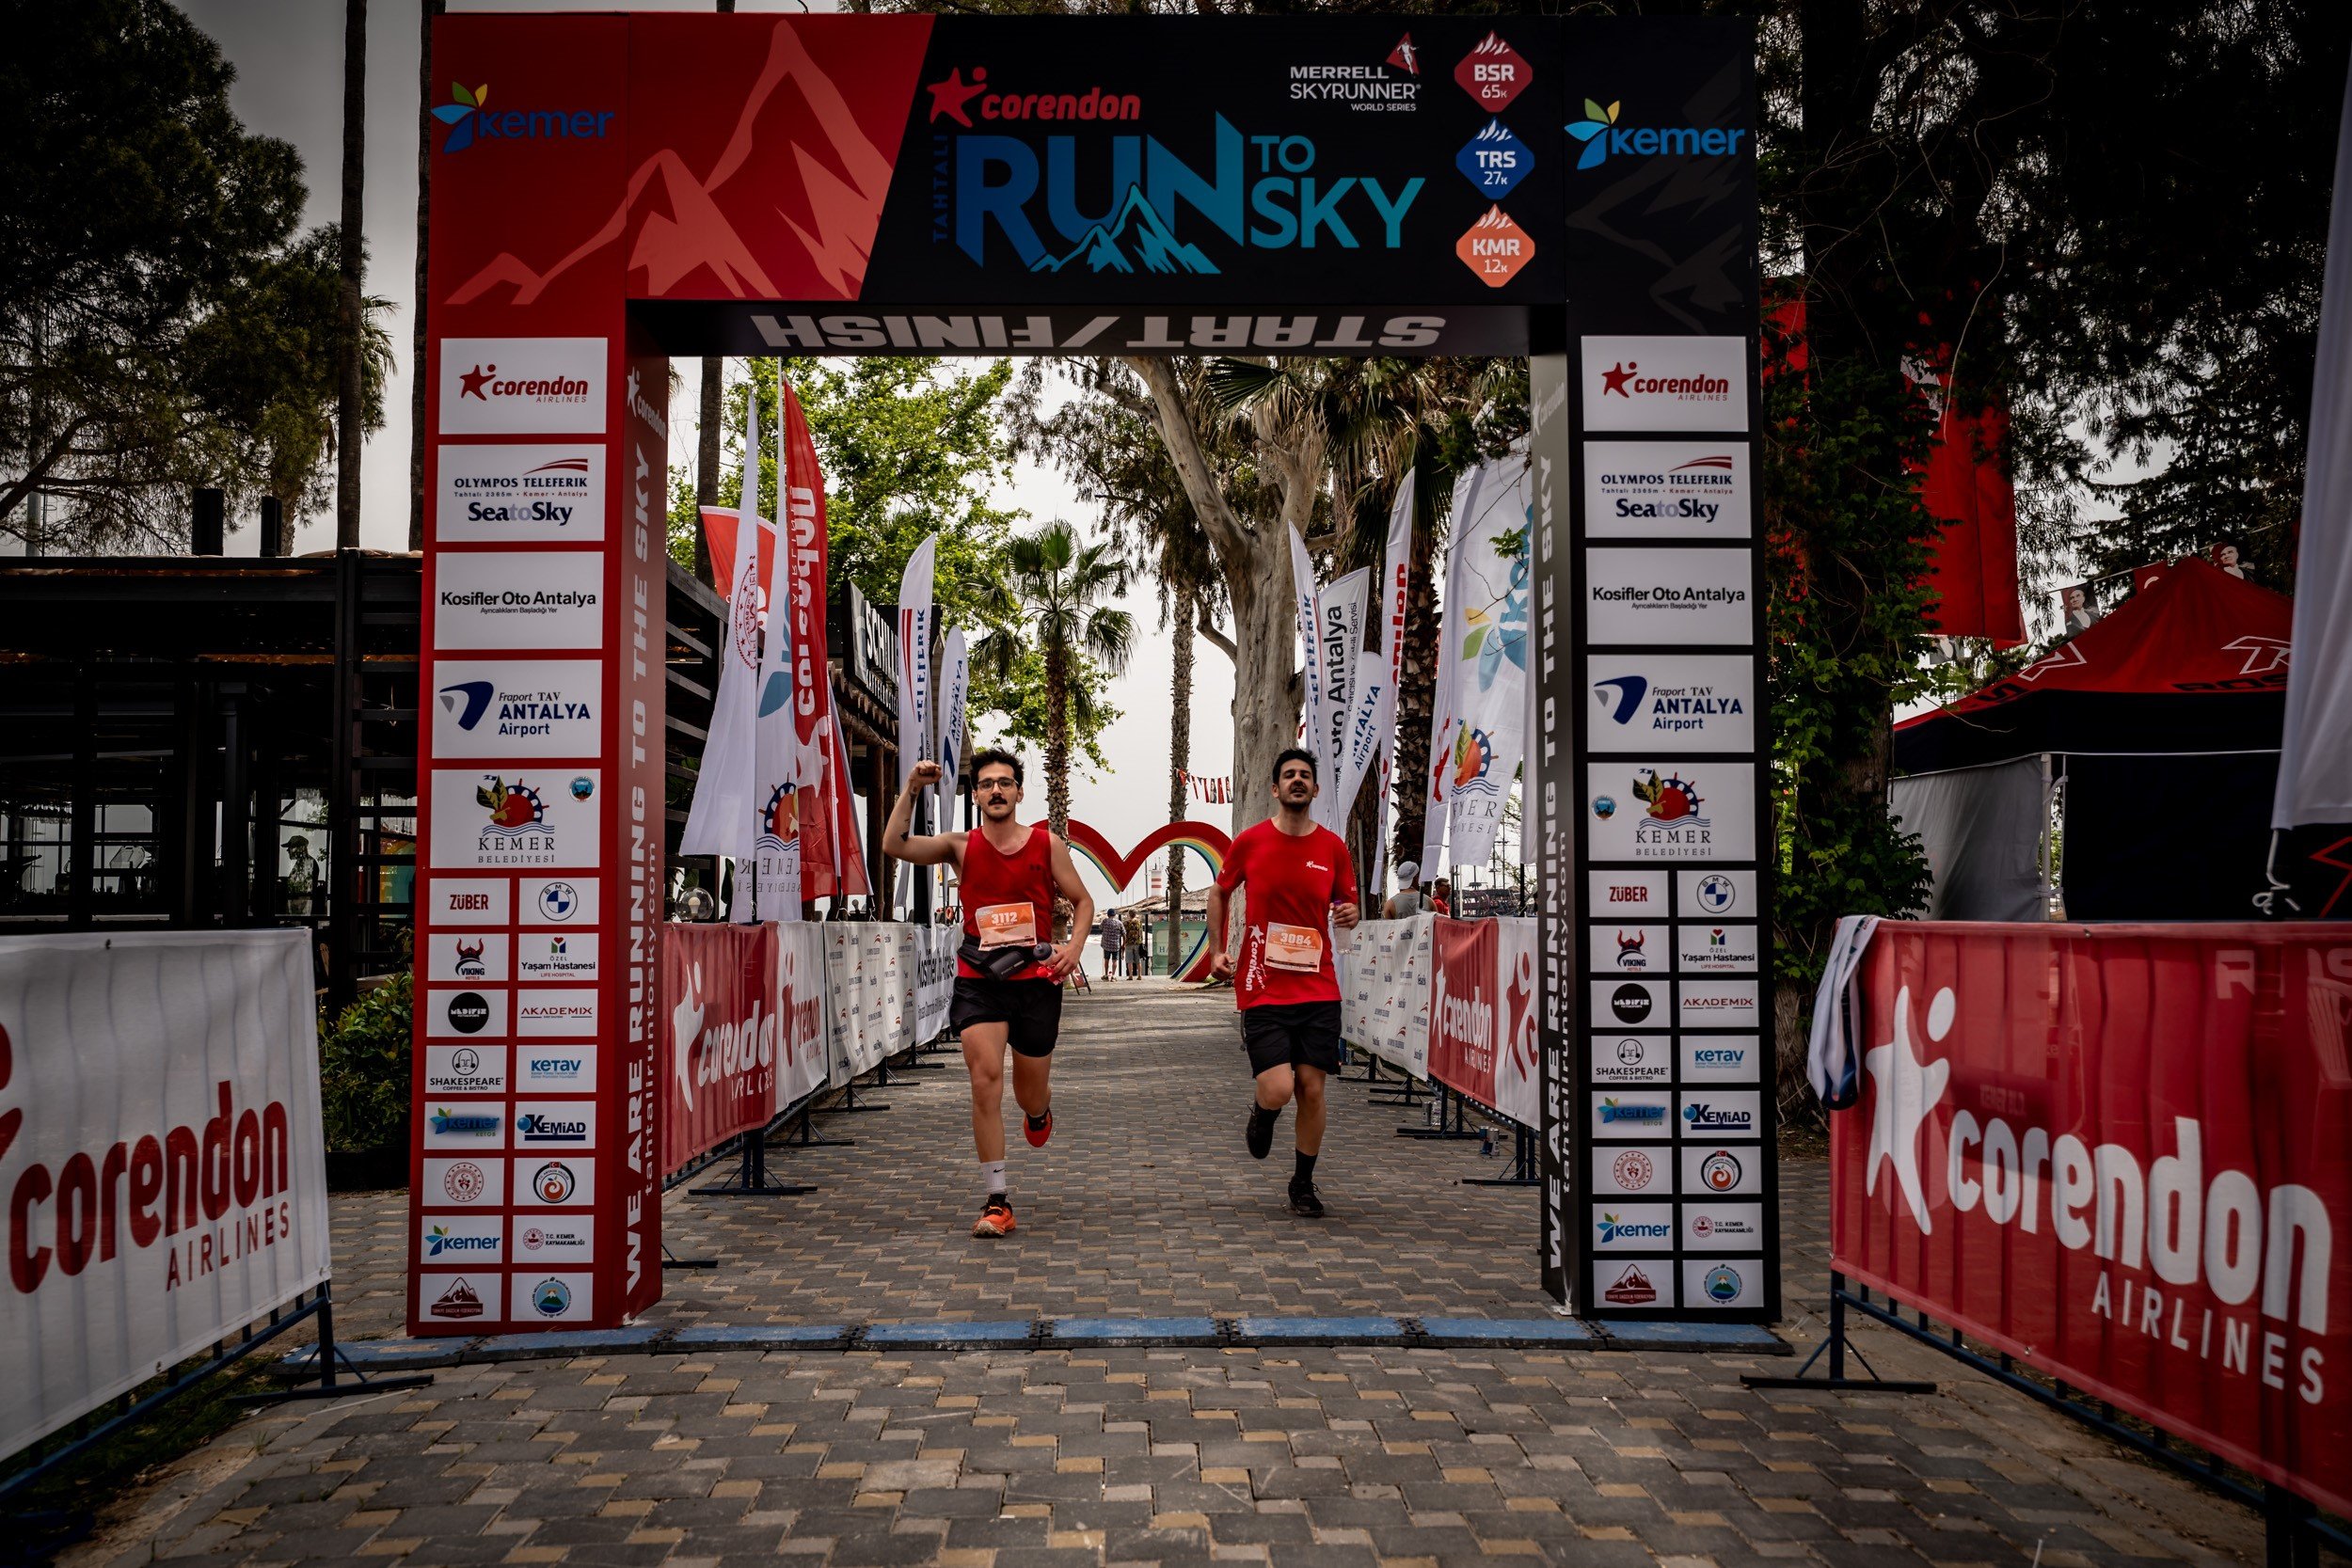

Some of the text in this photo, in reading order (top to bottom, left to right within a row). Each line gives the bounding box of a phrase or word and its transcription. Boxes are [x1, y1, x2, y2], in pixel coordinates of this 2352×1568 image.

[1289, 65, 1390, 80] MERRELL
[1473, 63, 1516, 83] BSR
[980, 87, 1142, 121] corendon
[1351, 102, 1417, 113] WORLD SERIES
[478, 104, 615, 140] kemer
[1610, 127, 1747, 157] kemer
[1250, 134, 1316, 174] TO
[1474, 150, 1517, 169] TRS
[932, 134, 948, 244] TAHTALI
[955, 109, 1245, 271] RUN
[1249, 176, 1427, 250] SKY
[1471, 238, 1520, 257] KMR
[750, 314, 1448, 349] START/FINISH
[491, 374, 589, 397] corendon
[1633, 373, 1729, 395] corendon
[535, 396, 588, 404] AIRLINES
[1677, 393, 1728, 403] AIRLINES
[637, 395, 666, 441] corendon
[453, 476, 588, 489] OLYMPOS TELEFERIK
[1600, 474, 1733, 485] OLYMPOS TELEFERIK
[467, 500, 574, 527] SeatoSky
[1614, 497, 1720, 524] SeatoSky
[440, 590, 596, 609] Kosifler Oto Antalya
[1592, 586, 1746, 605] Kosifler Oto Antalya
[1347, 602, 1359, 634] Servisi
[1324, 605, 1348, 704] Antalya
[498, 691, 562, 704] Fraport TAV
[949, 658, 963, 742] ANTALYA
[1652, 686, 1714, 699] Fraport TAV
[498, 703, 592, 721] ANTALYA
[1652, 698, 1744, 715] ANTALYA
[498, 721, 550, 737] Airport
[1652, 717, 1705, 733] Airport
[1354, 726, 1376, 771] Airport
[477, 837, 556, 851] KEMER
[1635, 830, 1712, 845] KEMER
[477, 853, 555, 863] BELEDİYESİ
[1635, 847, 1712, 857] BELEDİYESİ
[626, 441, 651, 1297] WE ARE RUNNING TO THE SKY
[1540, 455, 1562, 1270] WE ARE RUNNING TO THE SKY
[520, 960, 596, 973] Yaşam Hastanesi
[1245, 940, 1259, 991] corendon
[1622, 958, 1647, 968] VIKING
[1681, 953, 1756, 964] Yaşam Hastanesi
[460, 967, 486, 976] VIKING
[520, 1006, 594, 1016] AKADEMIX
[1683, 998, 1754, 1006] AKADEMIX
[1442, 985, 1493, 1053] corendon
[1596, 1067, 1667, 1076] SHAKESPEARE
[429, 1077, 502, 1086] SHAKESPEARE
[9, 1079, 289, 1294] corendon
[1614, 1223, 1671, 1238] kemer
[1947, 1109, 2332, 1337] corendon
[166, 1200, 290, 1292] AIRLINES
[443, 1234, 501, 1250] kemer
[2090, 1269, 2325, 1405] AIRLINES
